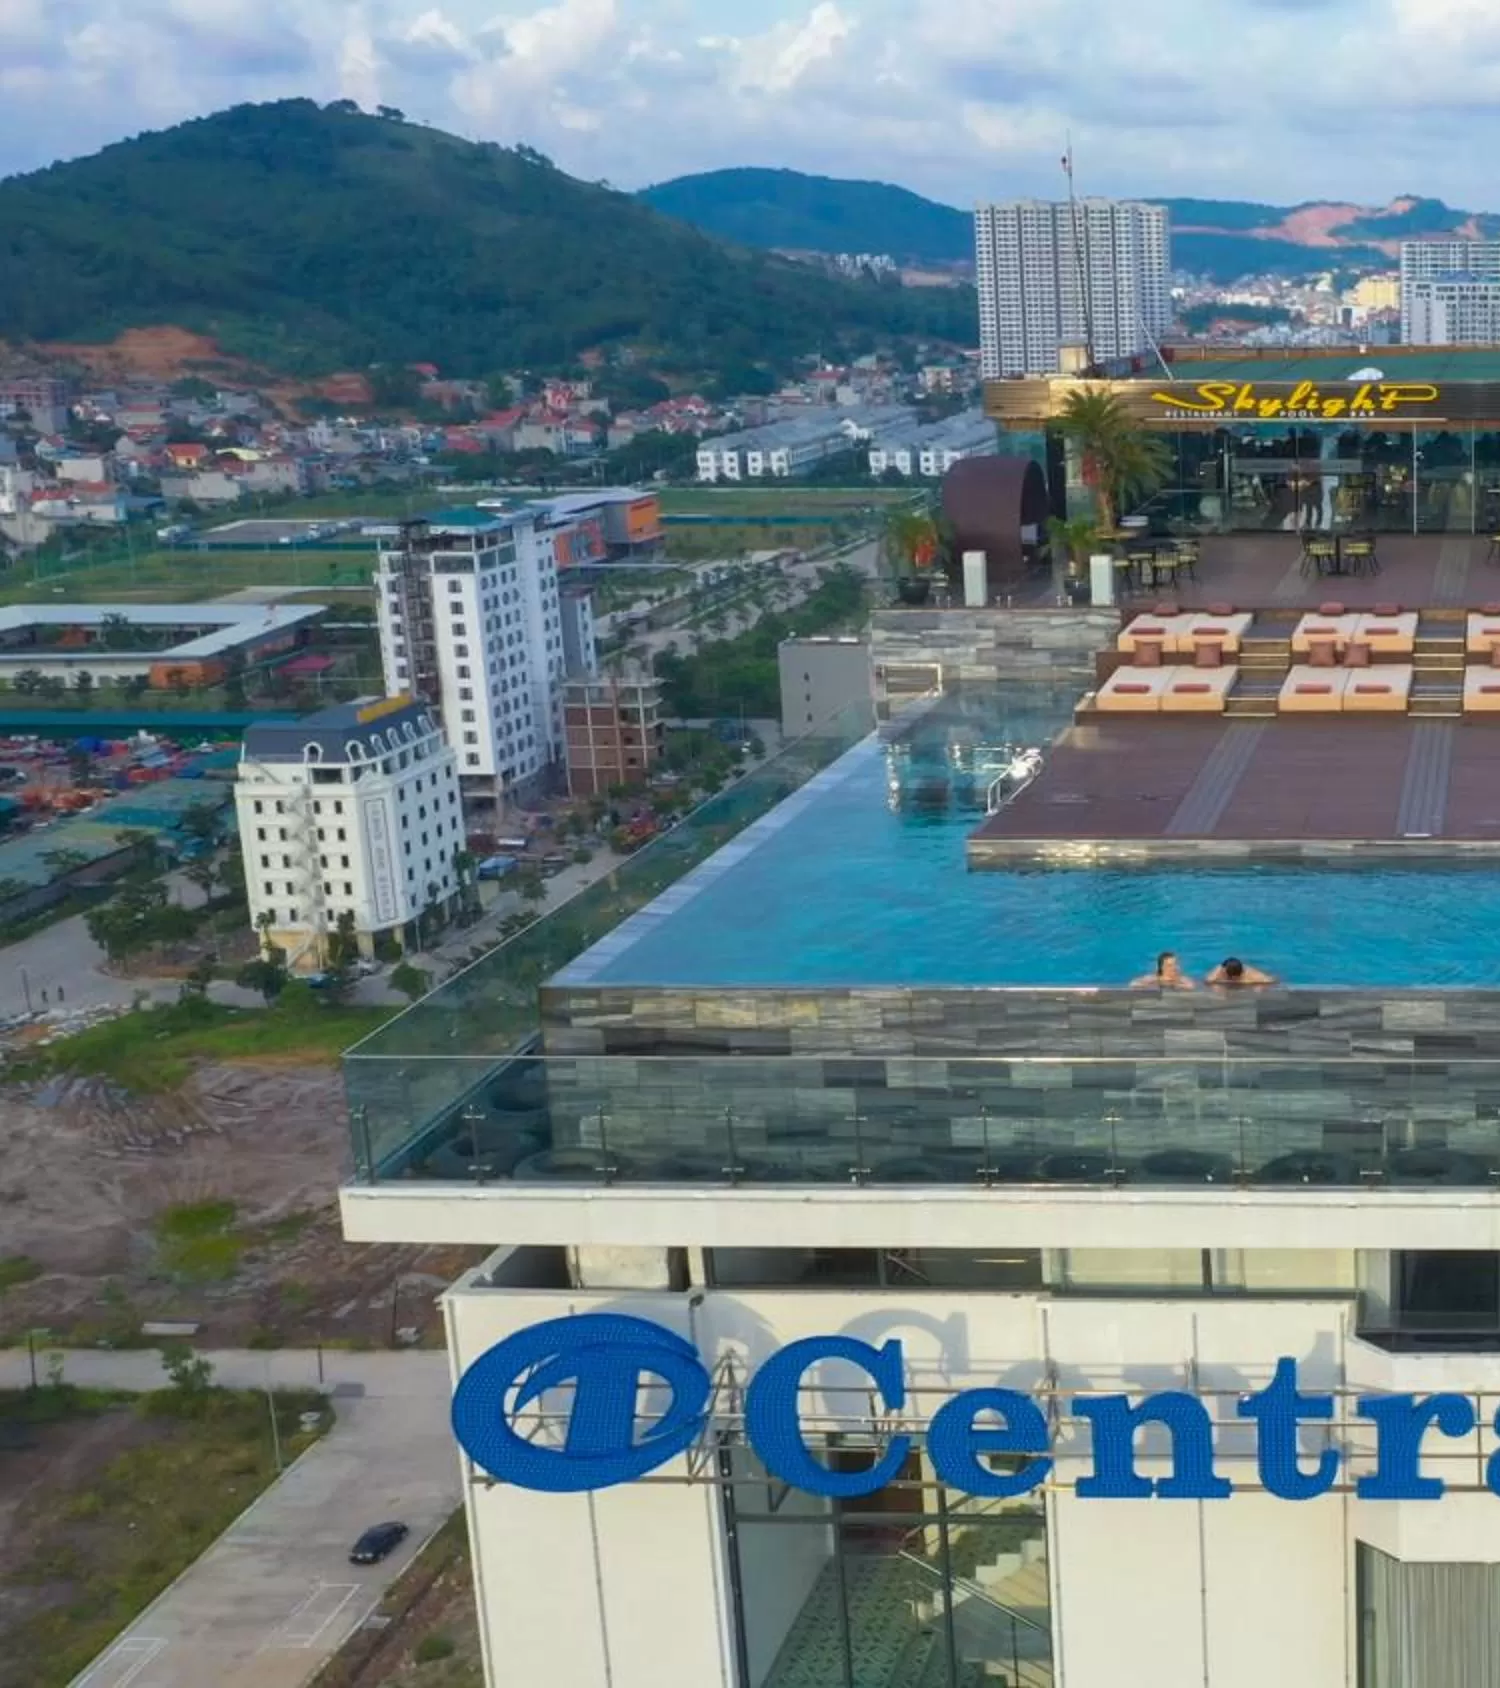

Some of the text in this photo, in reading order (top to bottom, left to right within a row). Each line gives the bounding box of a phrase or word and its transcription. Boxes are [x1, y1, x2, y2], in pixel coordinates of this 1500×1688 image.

[1152, 380, 1438, 417] Skylight
[1280, 409, 1315, 418] POOL
[1350, 409, 1376, 418] BAR
